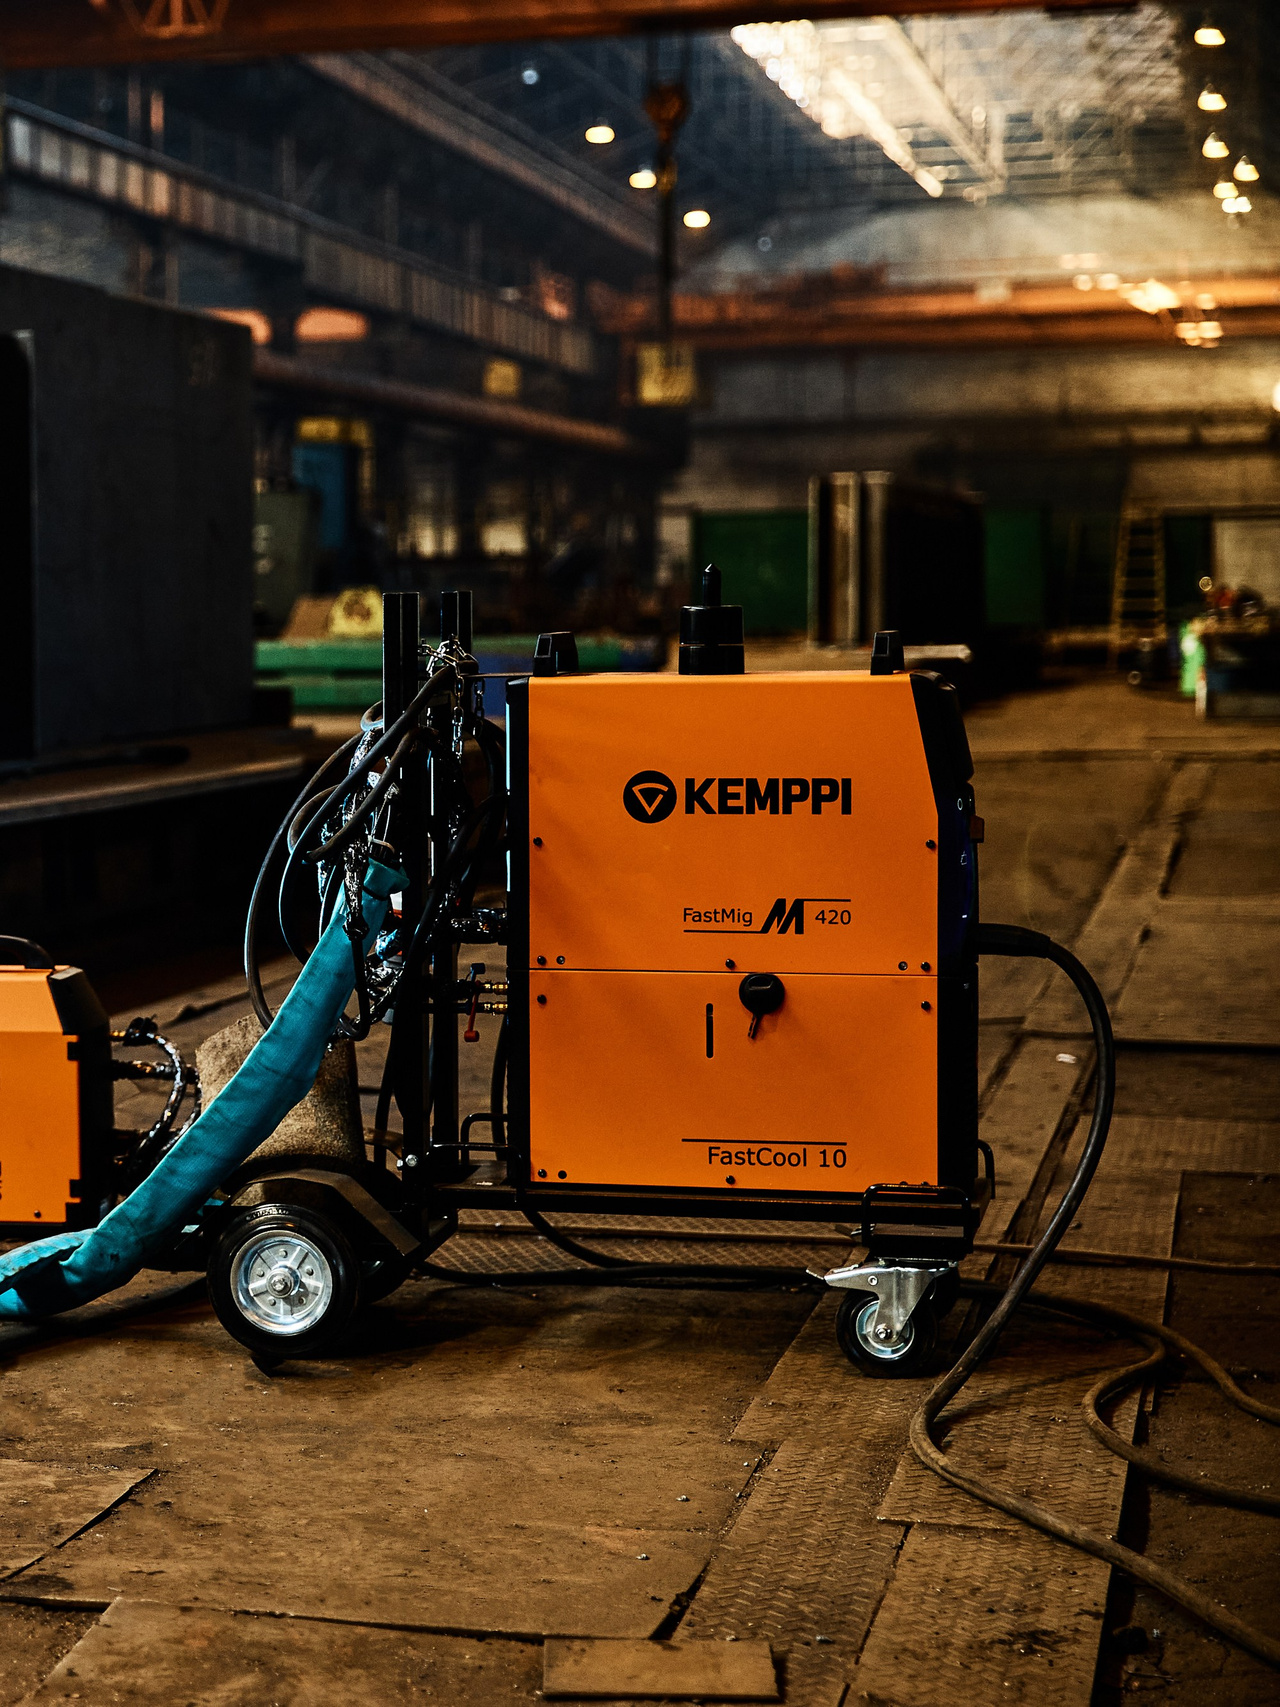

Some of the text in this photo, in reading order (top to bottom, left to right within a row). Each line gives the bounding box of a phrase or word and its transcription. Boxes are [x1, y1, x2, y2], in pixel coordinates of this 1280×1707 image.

[685, 777, 852, 815] KEMPPI
[682, 907, 753, 927] FastMig
[814, 909, 852, 925] 420
[707, 1145, 848, 1169] FastCool 10
